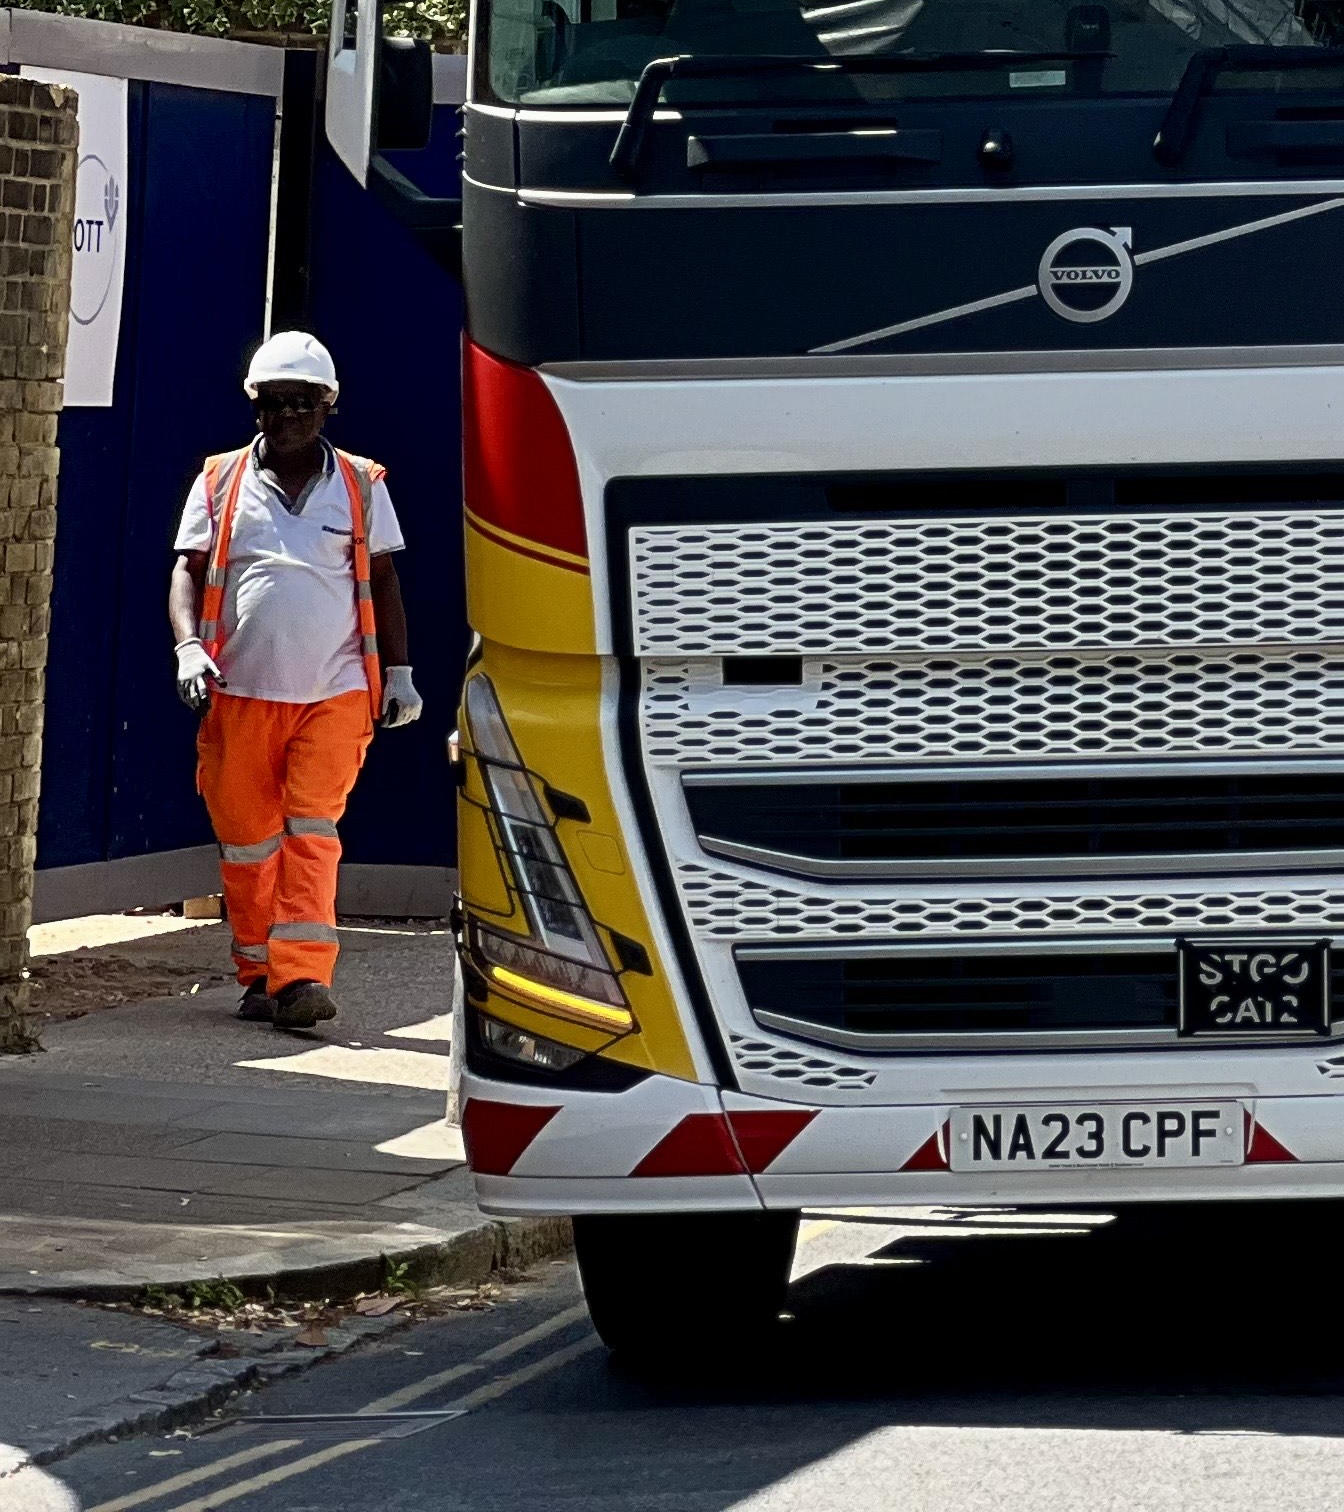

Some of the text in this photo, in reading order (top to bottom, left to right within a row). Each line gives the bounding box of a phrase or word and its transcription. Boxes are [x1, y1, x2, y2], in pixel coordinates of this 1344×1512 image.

[1051, 268, 1121, 281] VOLVO
[1199, 953, 1309, 986] STGO
[972, 1110, 1221, 1161] NA23 CPF
